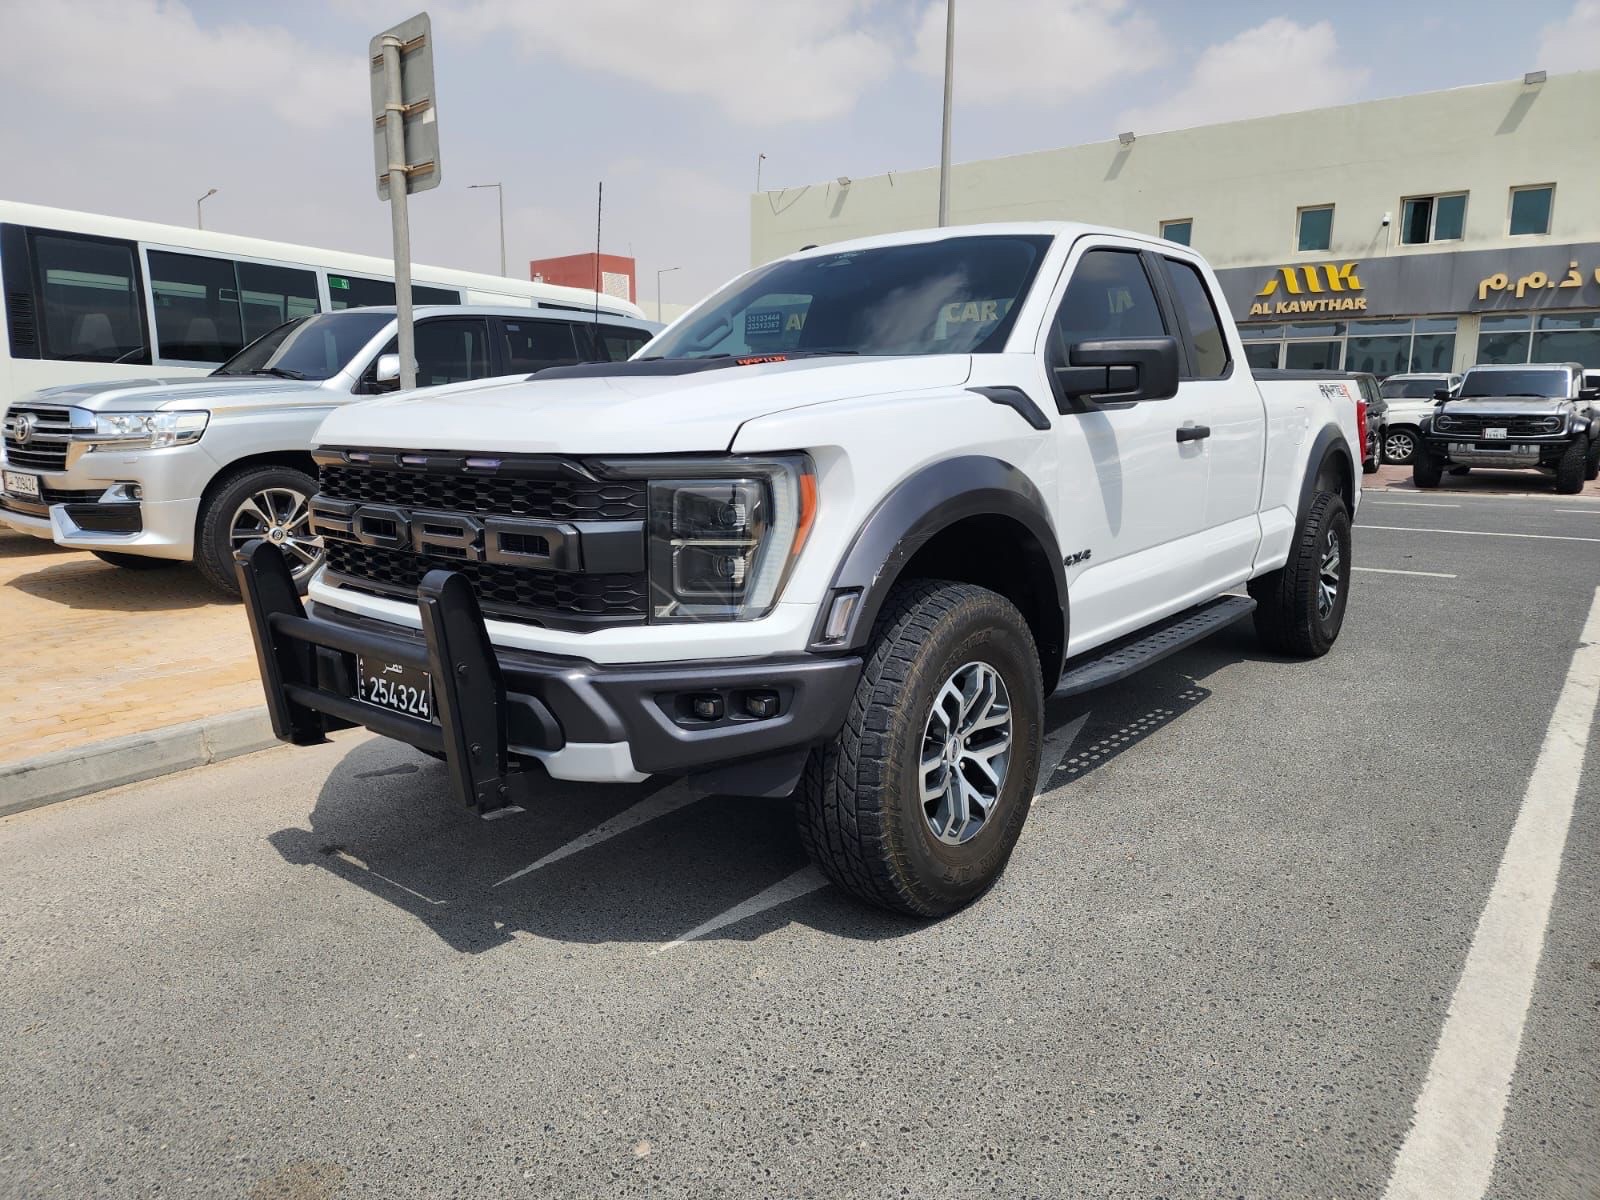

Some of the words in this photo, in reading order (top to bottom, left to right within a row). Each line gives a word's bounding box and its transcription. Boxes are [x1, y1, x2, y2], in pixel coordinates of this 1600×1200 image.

[946, 302, 999, 323] CAR
[1249, 303, 1272, 315] AL
[1276, 298, 1367, 314] KAWTHAR
[370, 677, 429, 717] 254324
